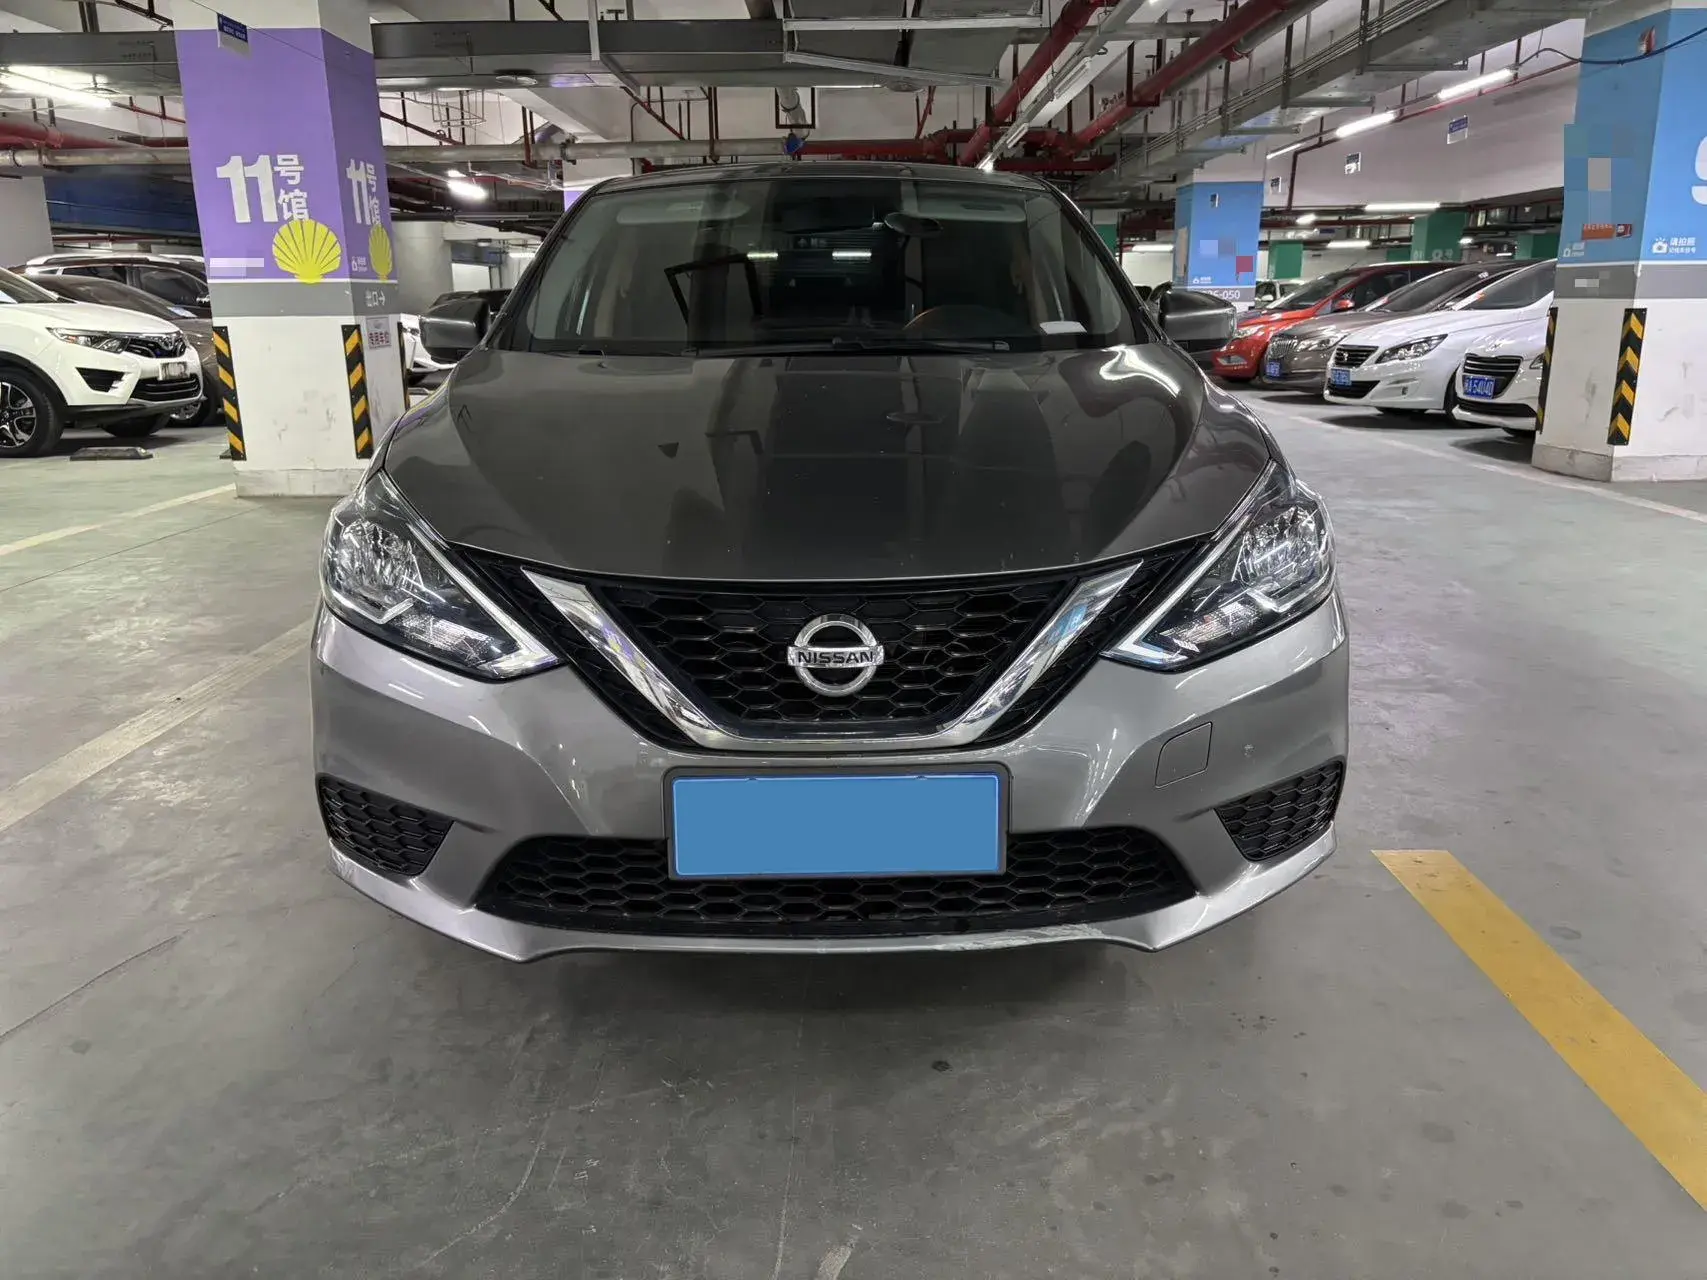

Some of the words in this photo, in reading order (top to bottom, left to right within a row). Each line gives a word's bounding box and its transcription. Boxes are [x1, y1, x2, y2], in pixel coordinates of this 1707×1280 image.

[216, 155, 279, 224] 11
[346, 158, 372, 226] 11
[797, 651, 874, 664] NISSAN
